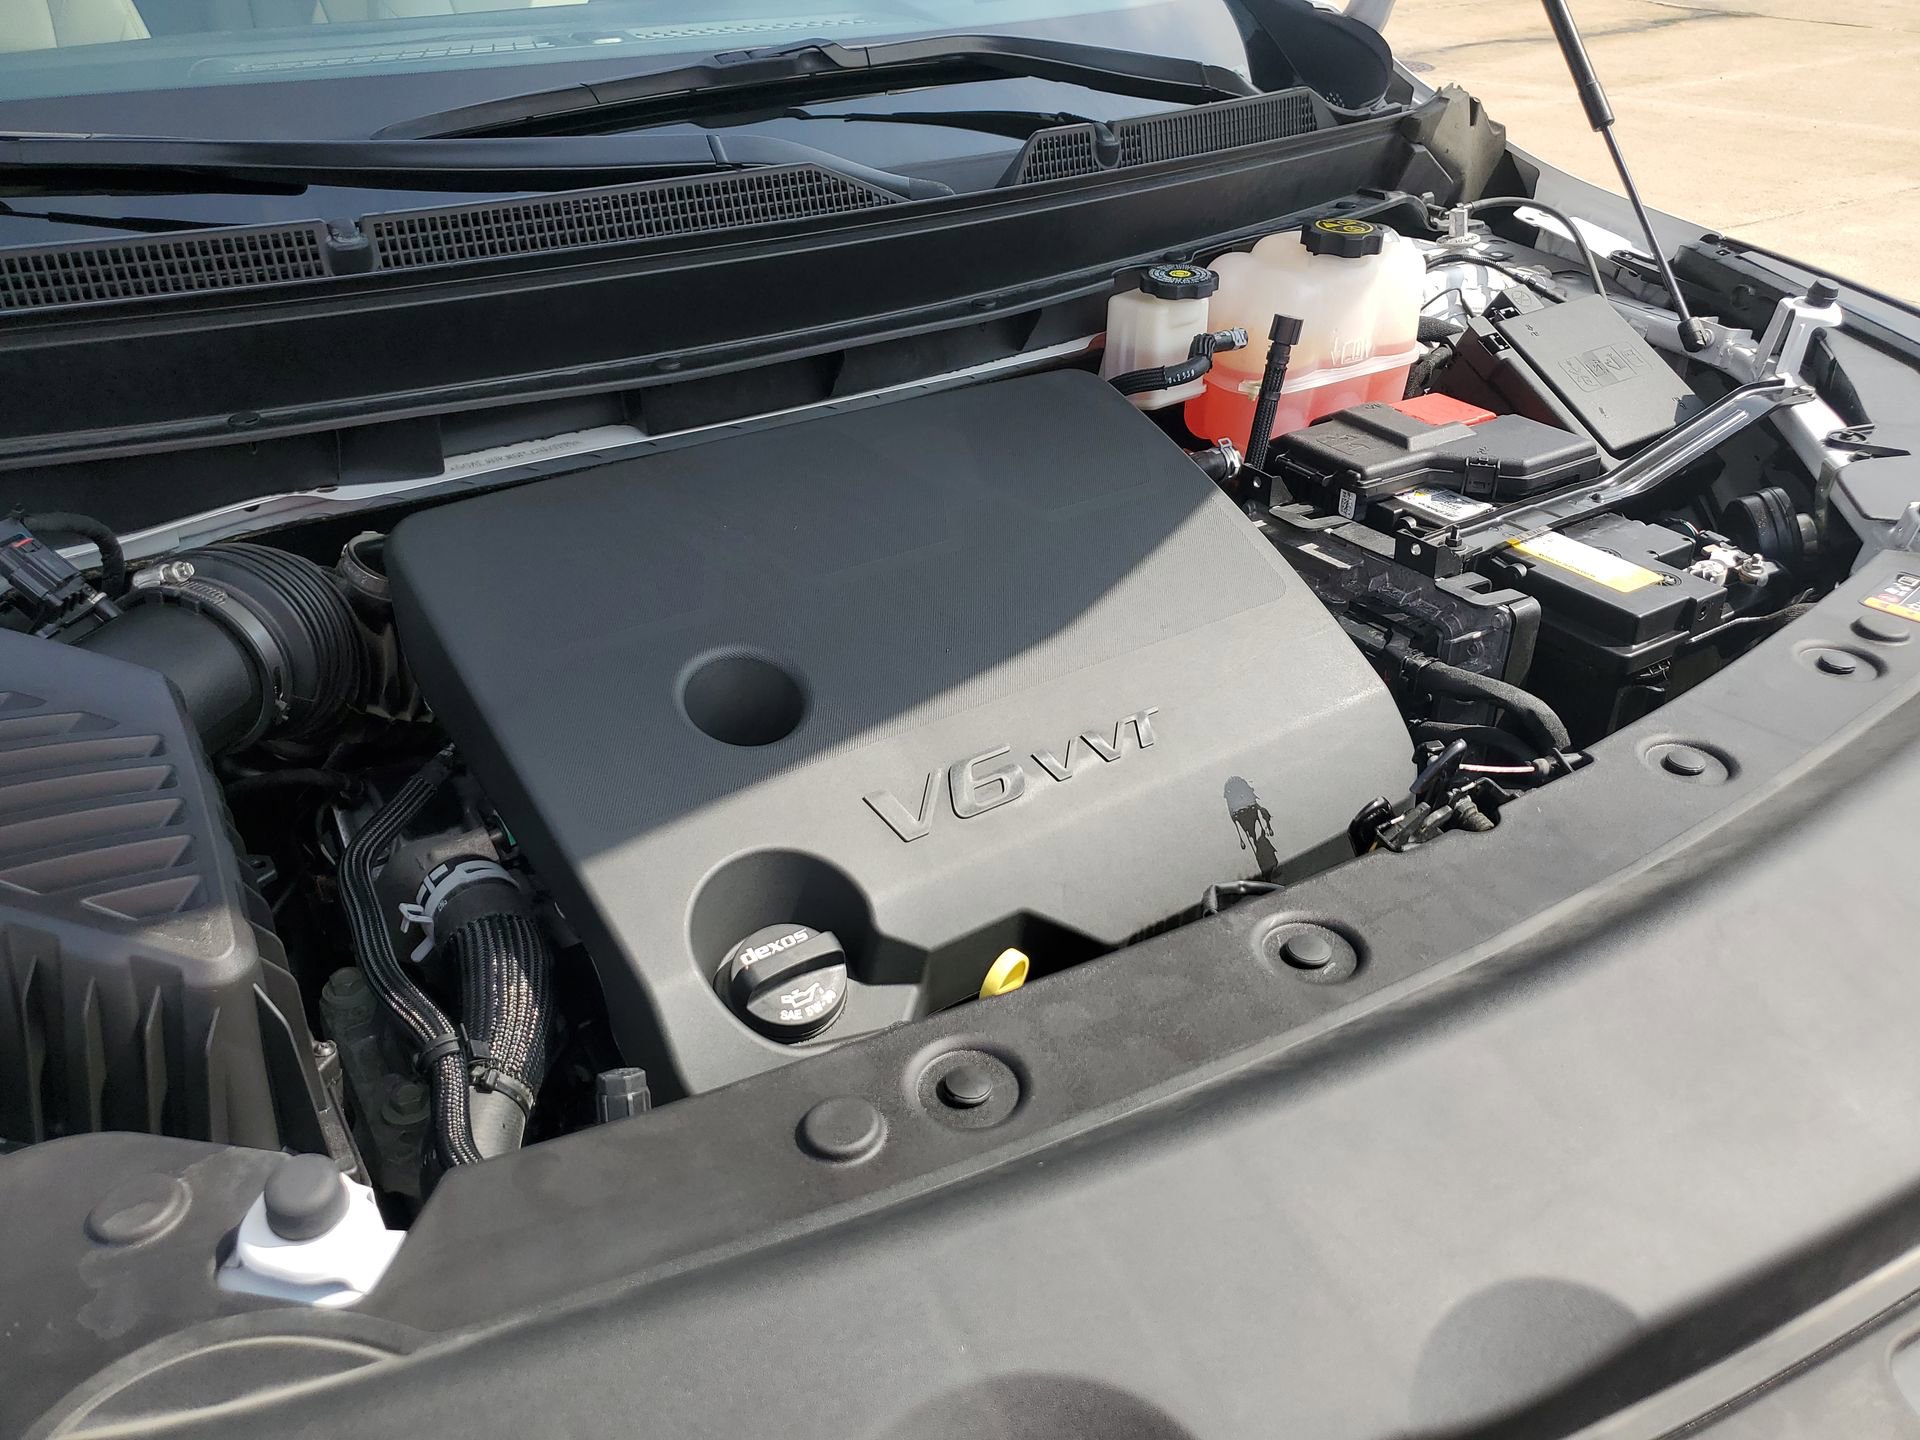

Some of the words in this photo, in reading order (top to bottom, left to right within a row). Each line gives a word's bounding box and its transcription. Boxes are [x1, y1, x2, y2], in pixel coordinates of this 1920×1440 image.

[862, 743, 1026, 843] V6
[1030, 705, 1159, 782] VVT
[740, 928, 808, 966] dexos
[780, 1009, 803, 1020] SAE
